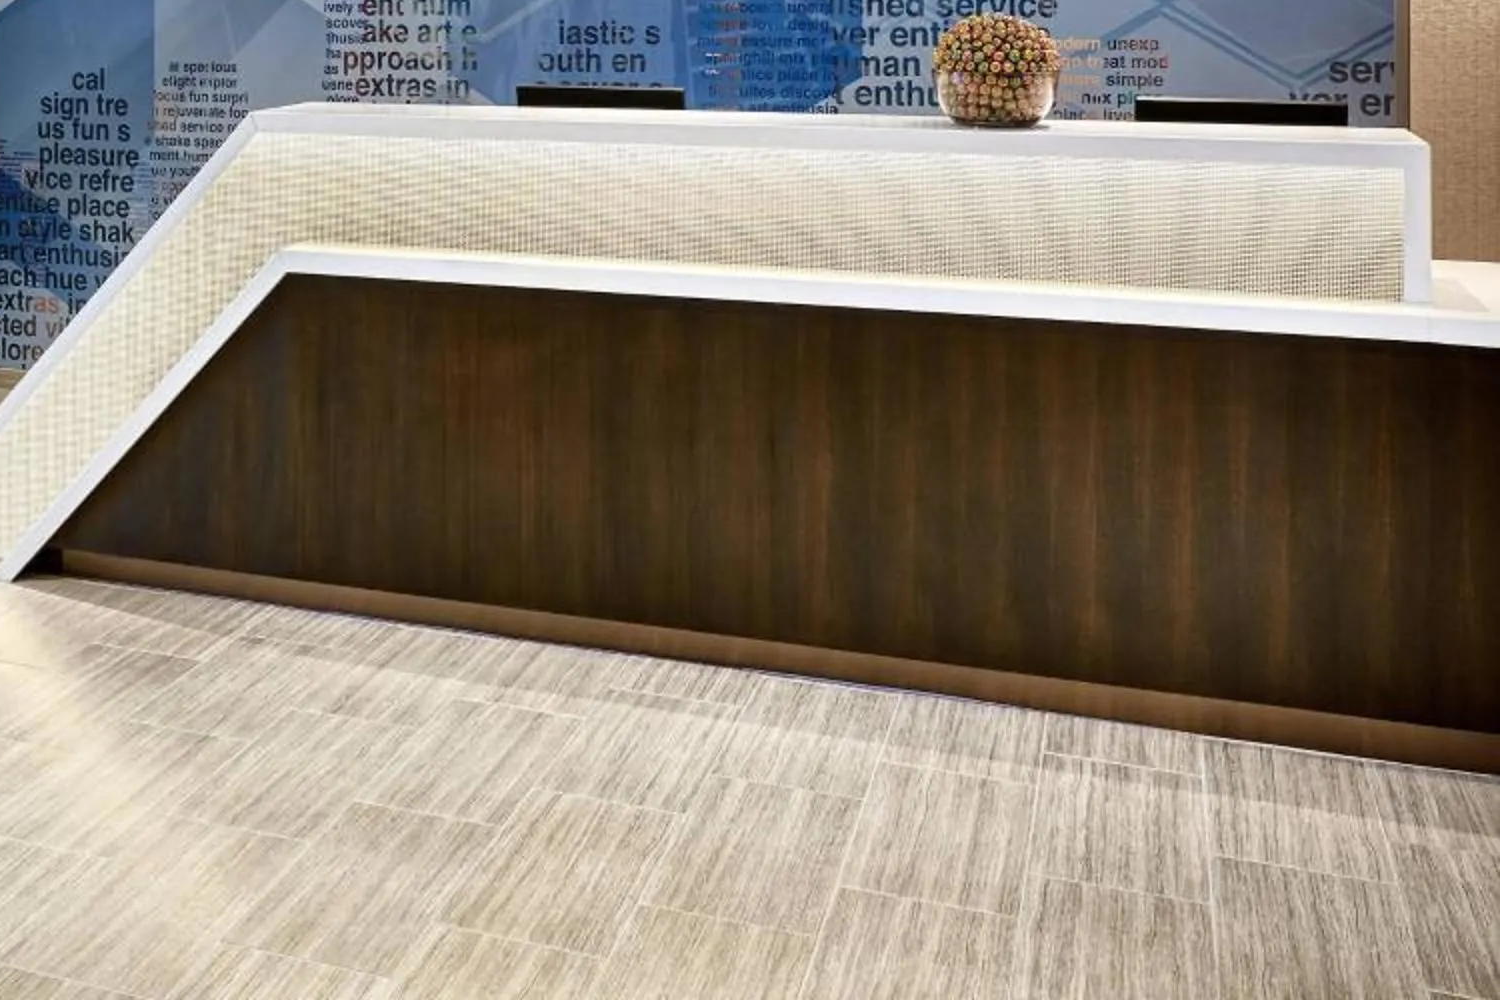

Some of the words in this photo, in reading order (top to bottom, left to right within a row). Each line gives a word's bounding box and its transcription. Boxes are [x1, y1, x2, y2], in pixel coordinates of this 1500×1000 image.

[558, 19, 635, 46] iastic
[644, 24, 661, 45] s
[611, 52, 647, 73] en
[71, 67, 105, 91] cal
[354, 73, 437, 98] extras
[1105, 71, 1165, 90] simple
[39, 91, 89, 121] sign
[97, 95, 129, 117] tre
[37, 121, 65, 139] us
[72, 120, 109, 142] fun
[117, 125, 131, 142] s
[38, 143, 140, 169] pleasure
[79, 170, 135, 194] refre
[67, 195, 131, 220] place
[78, 221, 135, 244] shak
[45, 266, 89, 291] hue
